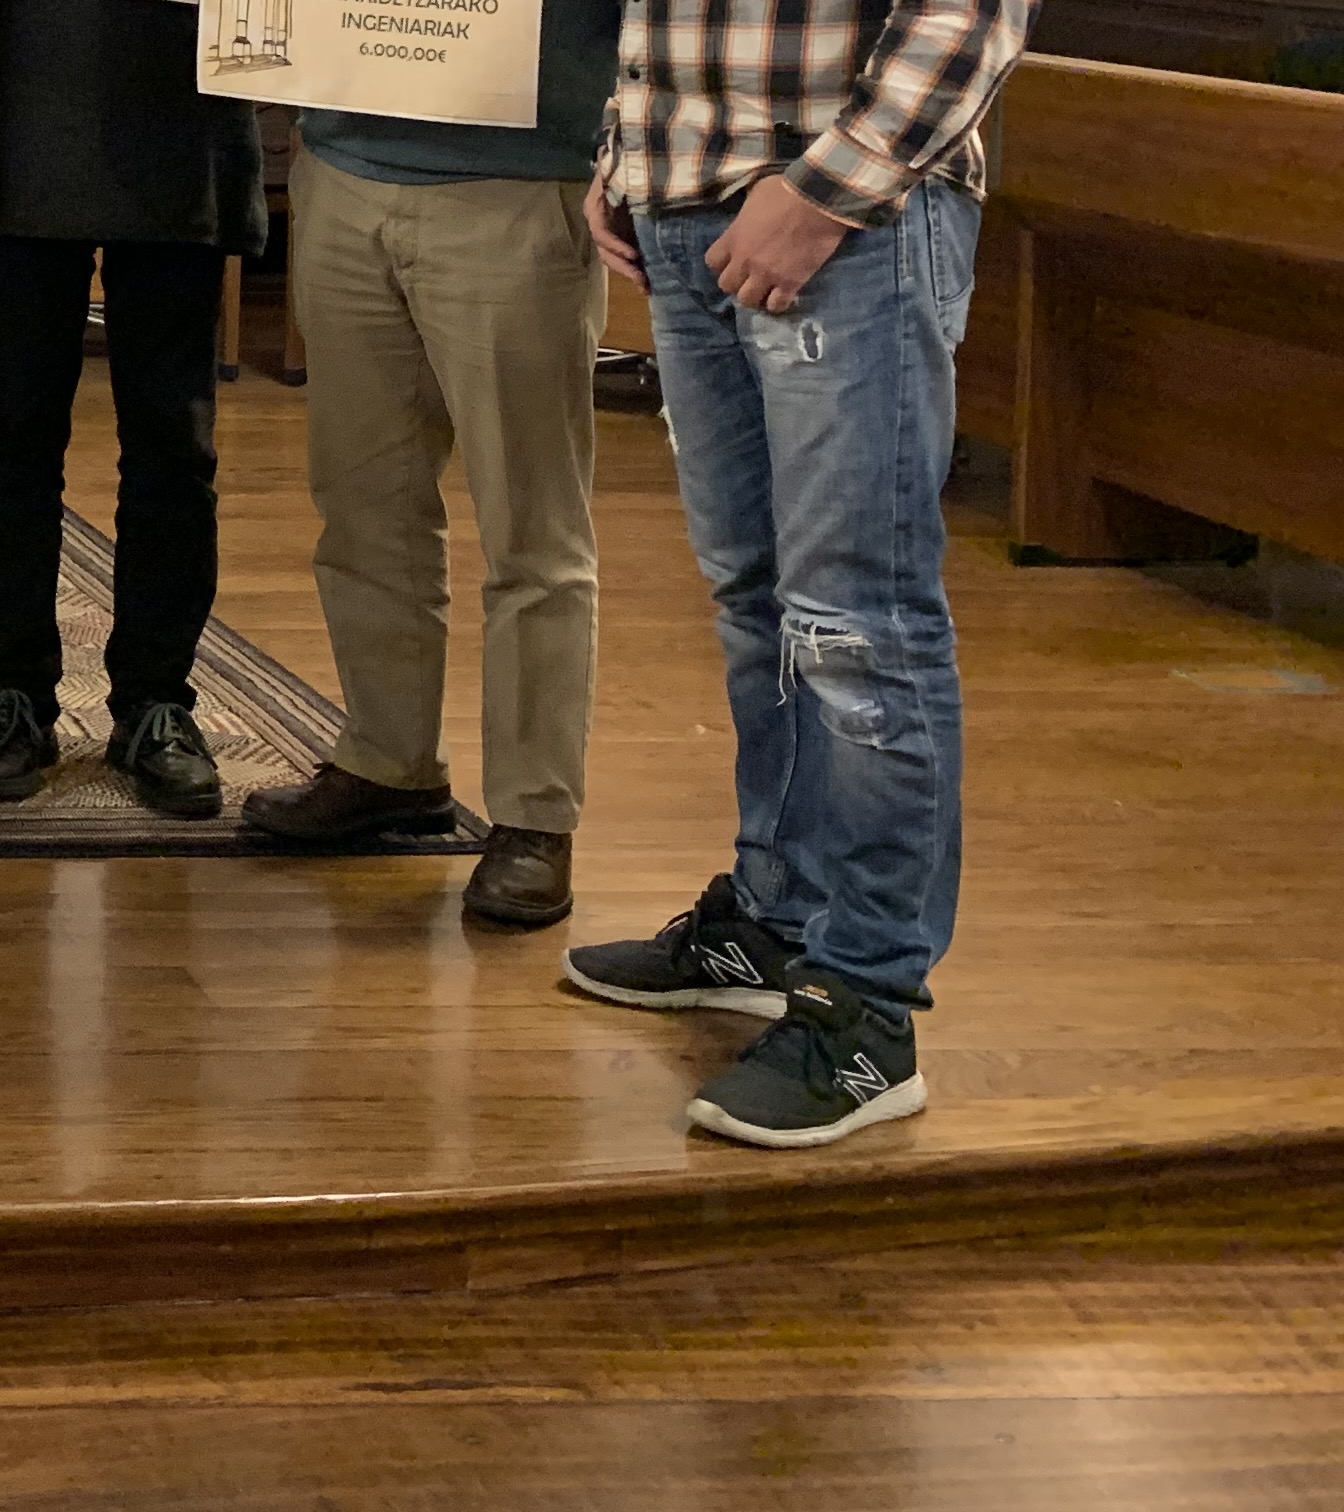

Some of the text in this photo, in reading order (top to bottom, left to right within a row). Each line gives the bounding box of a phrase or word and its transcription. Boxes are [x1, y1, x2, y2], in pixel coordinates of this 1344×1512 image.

[342, 12, 470, 39] INGENIARIAK
[359, 43, 447, 63] 6.000,00€
[692, 942, 763, 984] N
[833, 1053, 889, 1105] N
